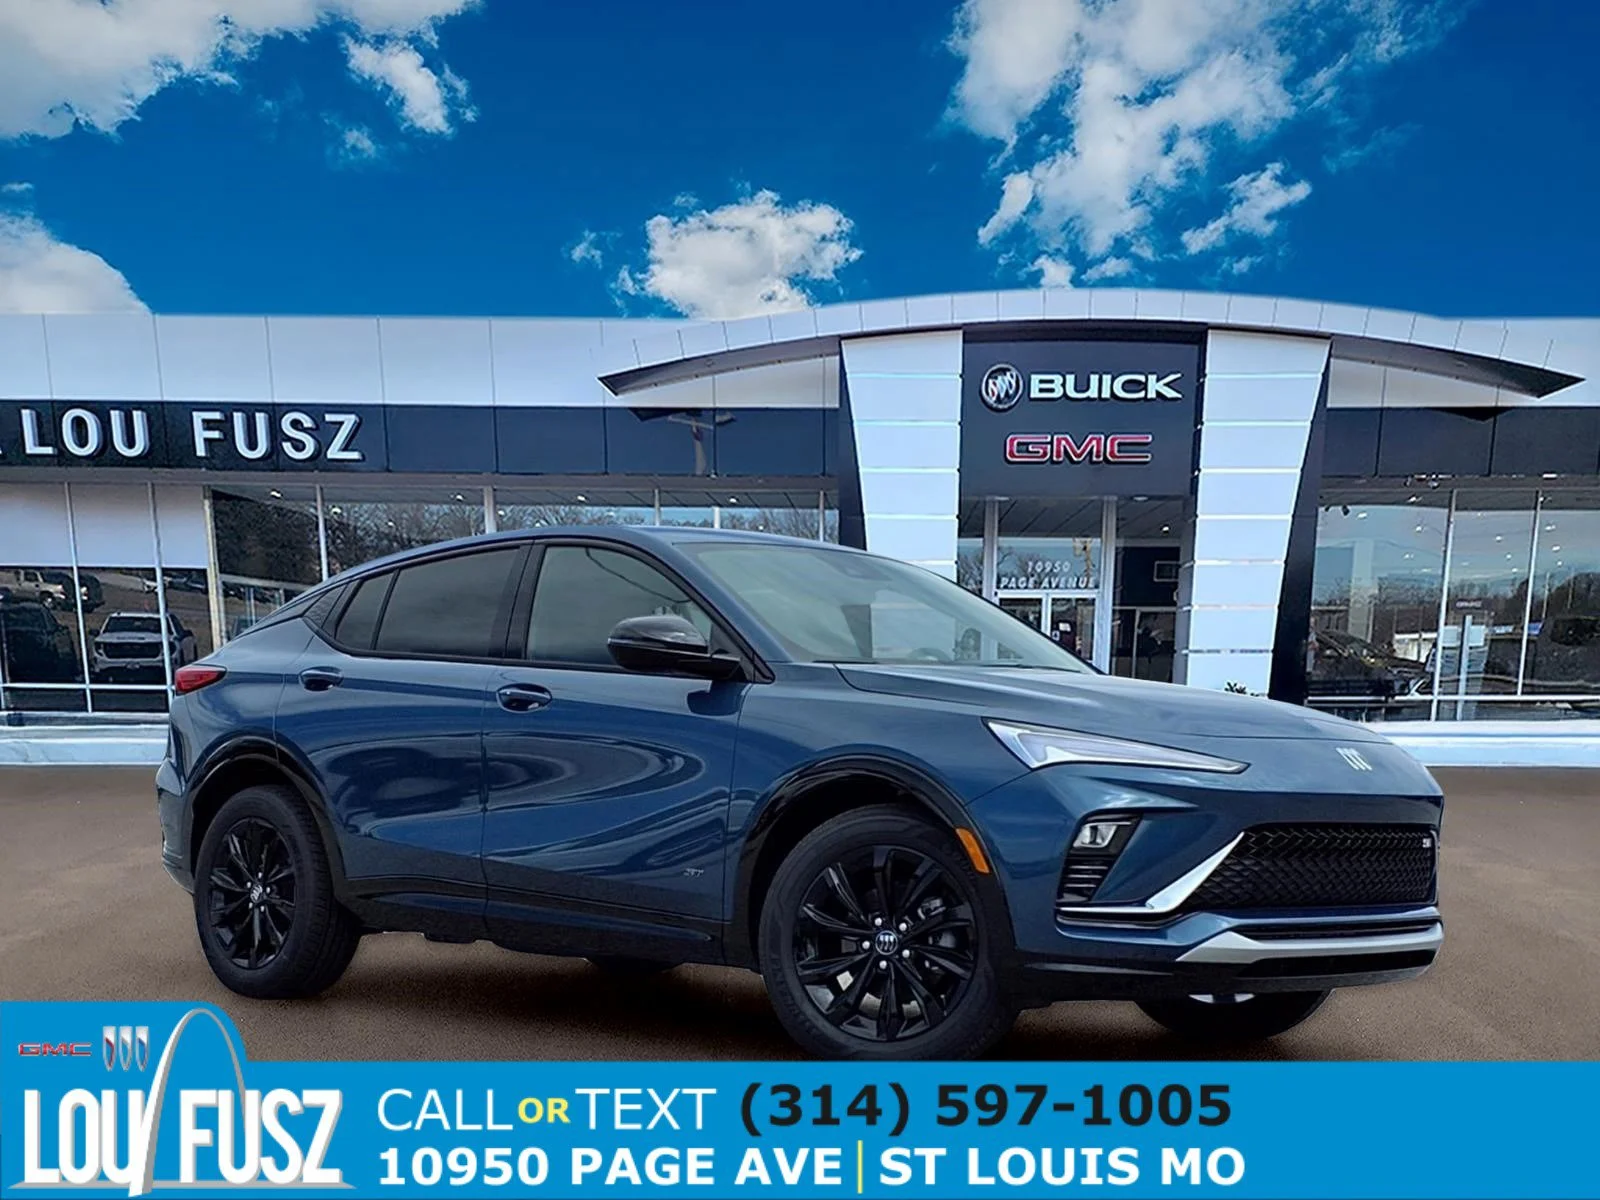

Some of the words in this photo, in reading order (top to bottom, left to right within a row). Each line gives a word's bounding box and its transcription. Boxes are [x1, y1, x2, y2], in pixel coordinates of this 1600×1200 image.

[1029, 373, 1183, 400] BUICK
[20, 408, 150, 458] LOU
[191, 410, 363, 461] FUSZ
[1005, 434, 1152, 462] GMC
[1027, 561, 1071, 573] 10950
[1000, 576, 1036, 588] PAGE
[1040, 576, 1096, 588] AVENUE
